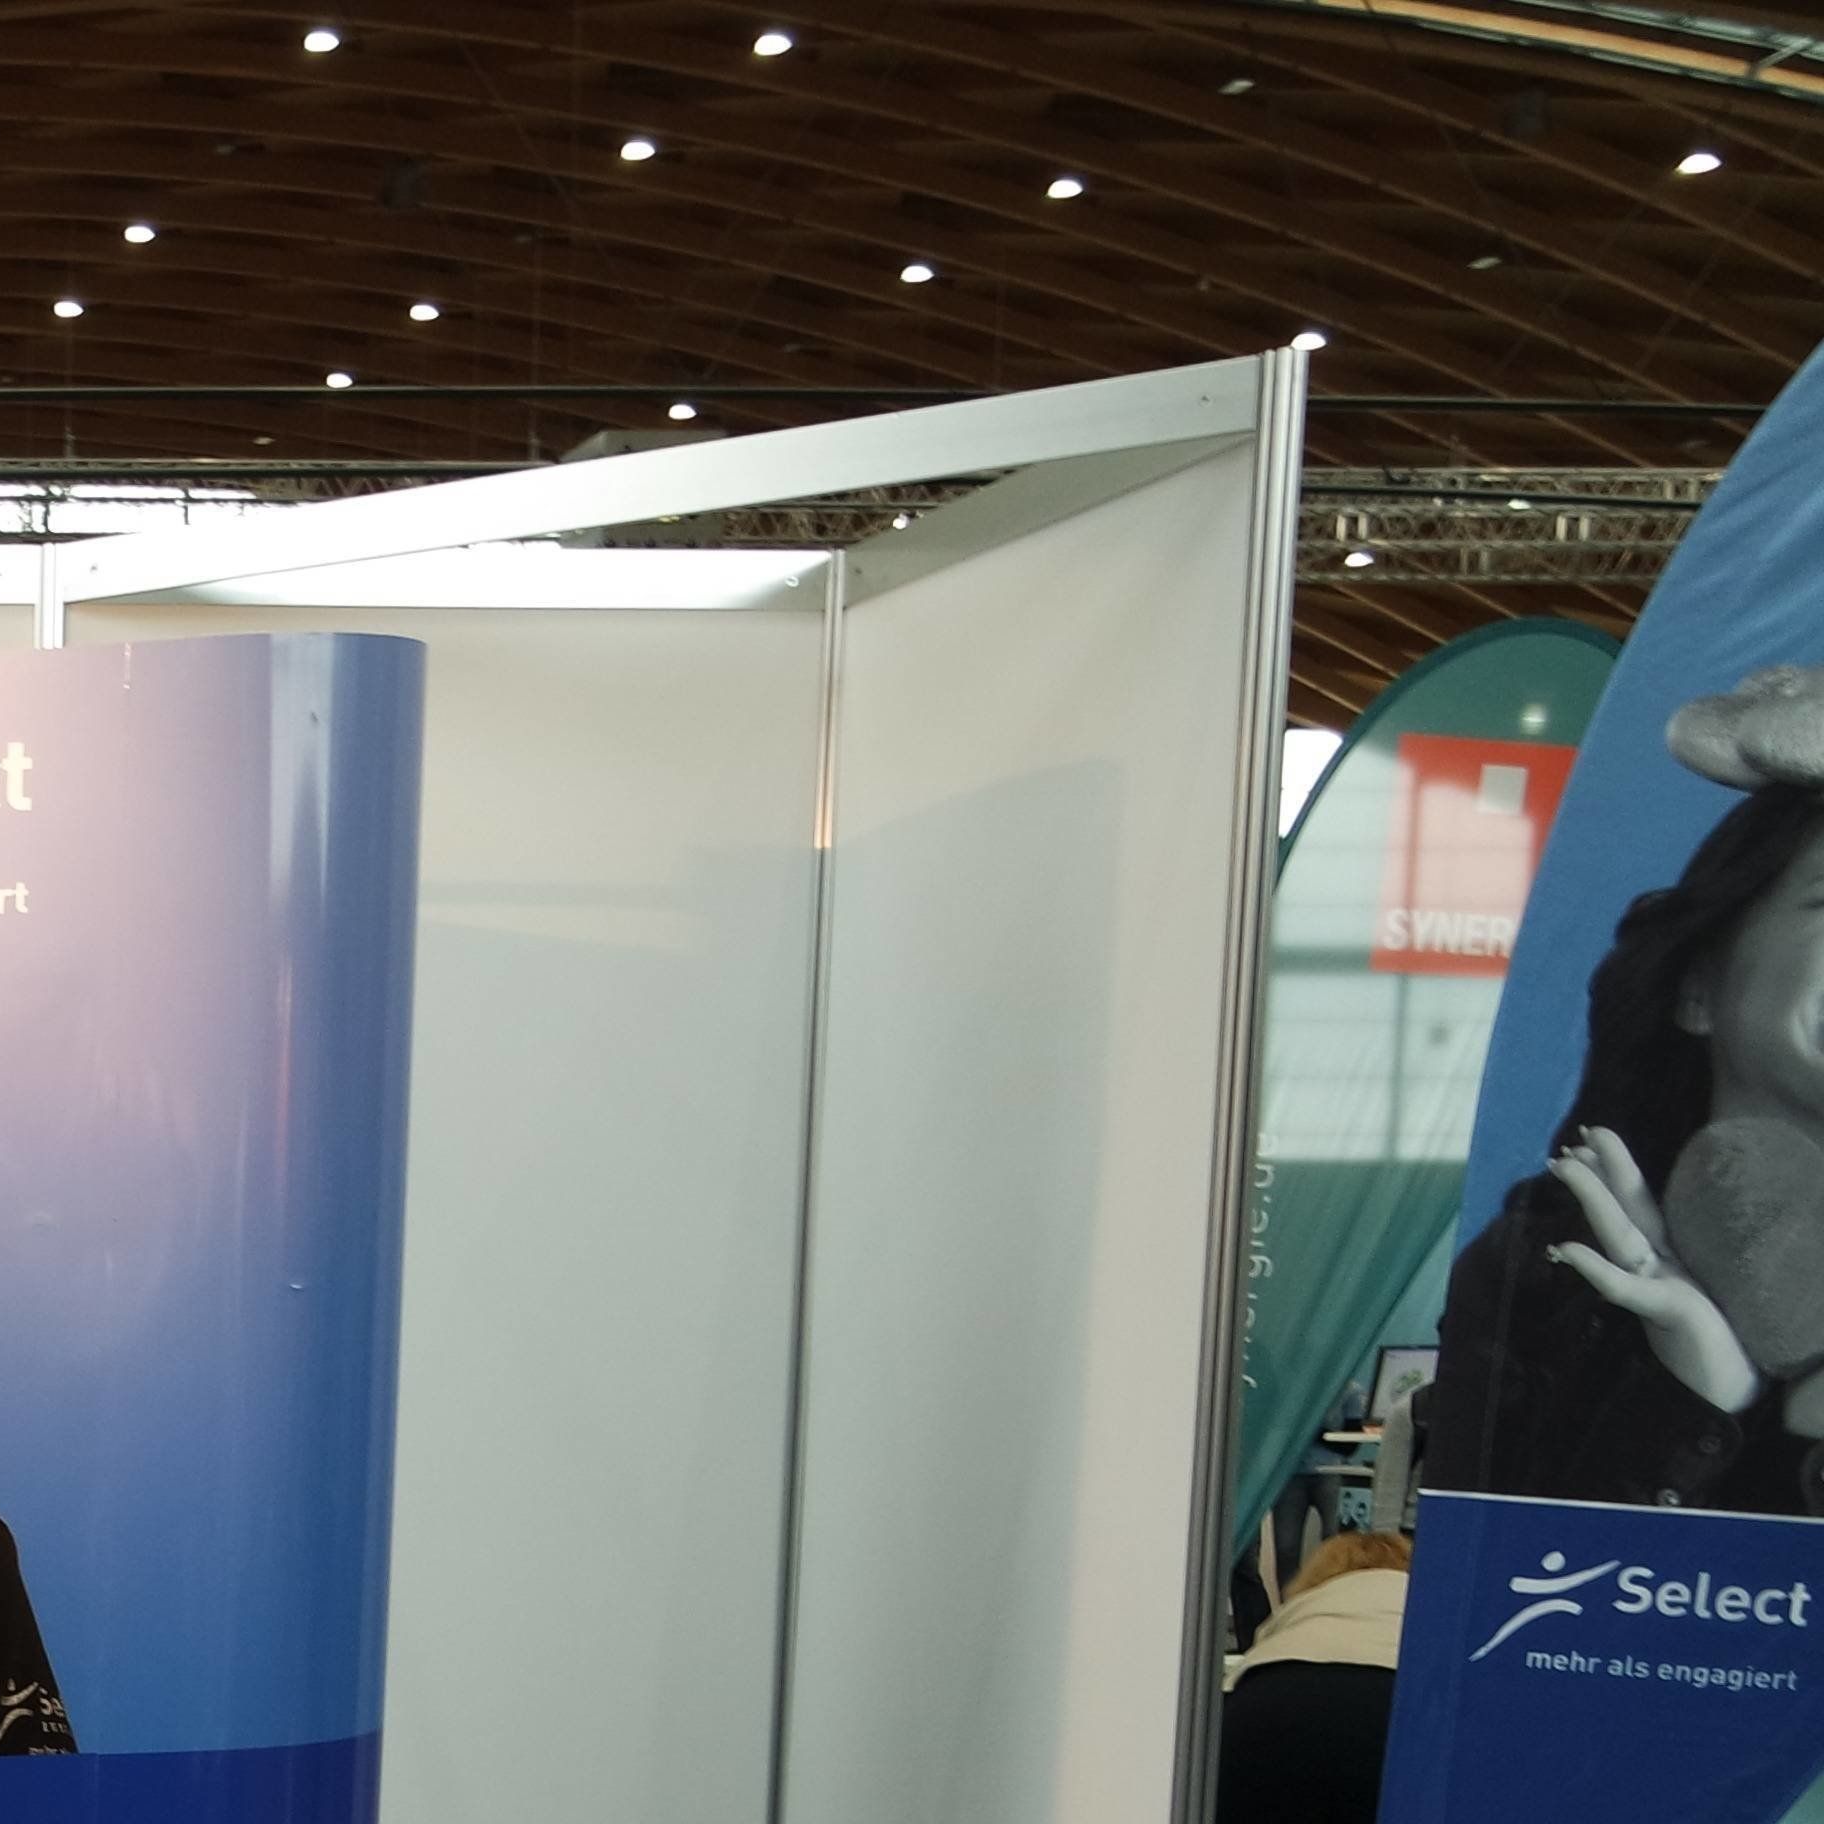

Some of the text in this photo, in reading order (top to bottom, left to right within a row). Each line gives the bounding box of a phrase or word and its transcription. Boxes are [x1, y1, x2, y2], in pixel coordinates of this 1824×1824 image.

[1612, 1565, 1812, 1627] Select
[1525, 1650, 1798, 1692] mehr als engagiert
